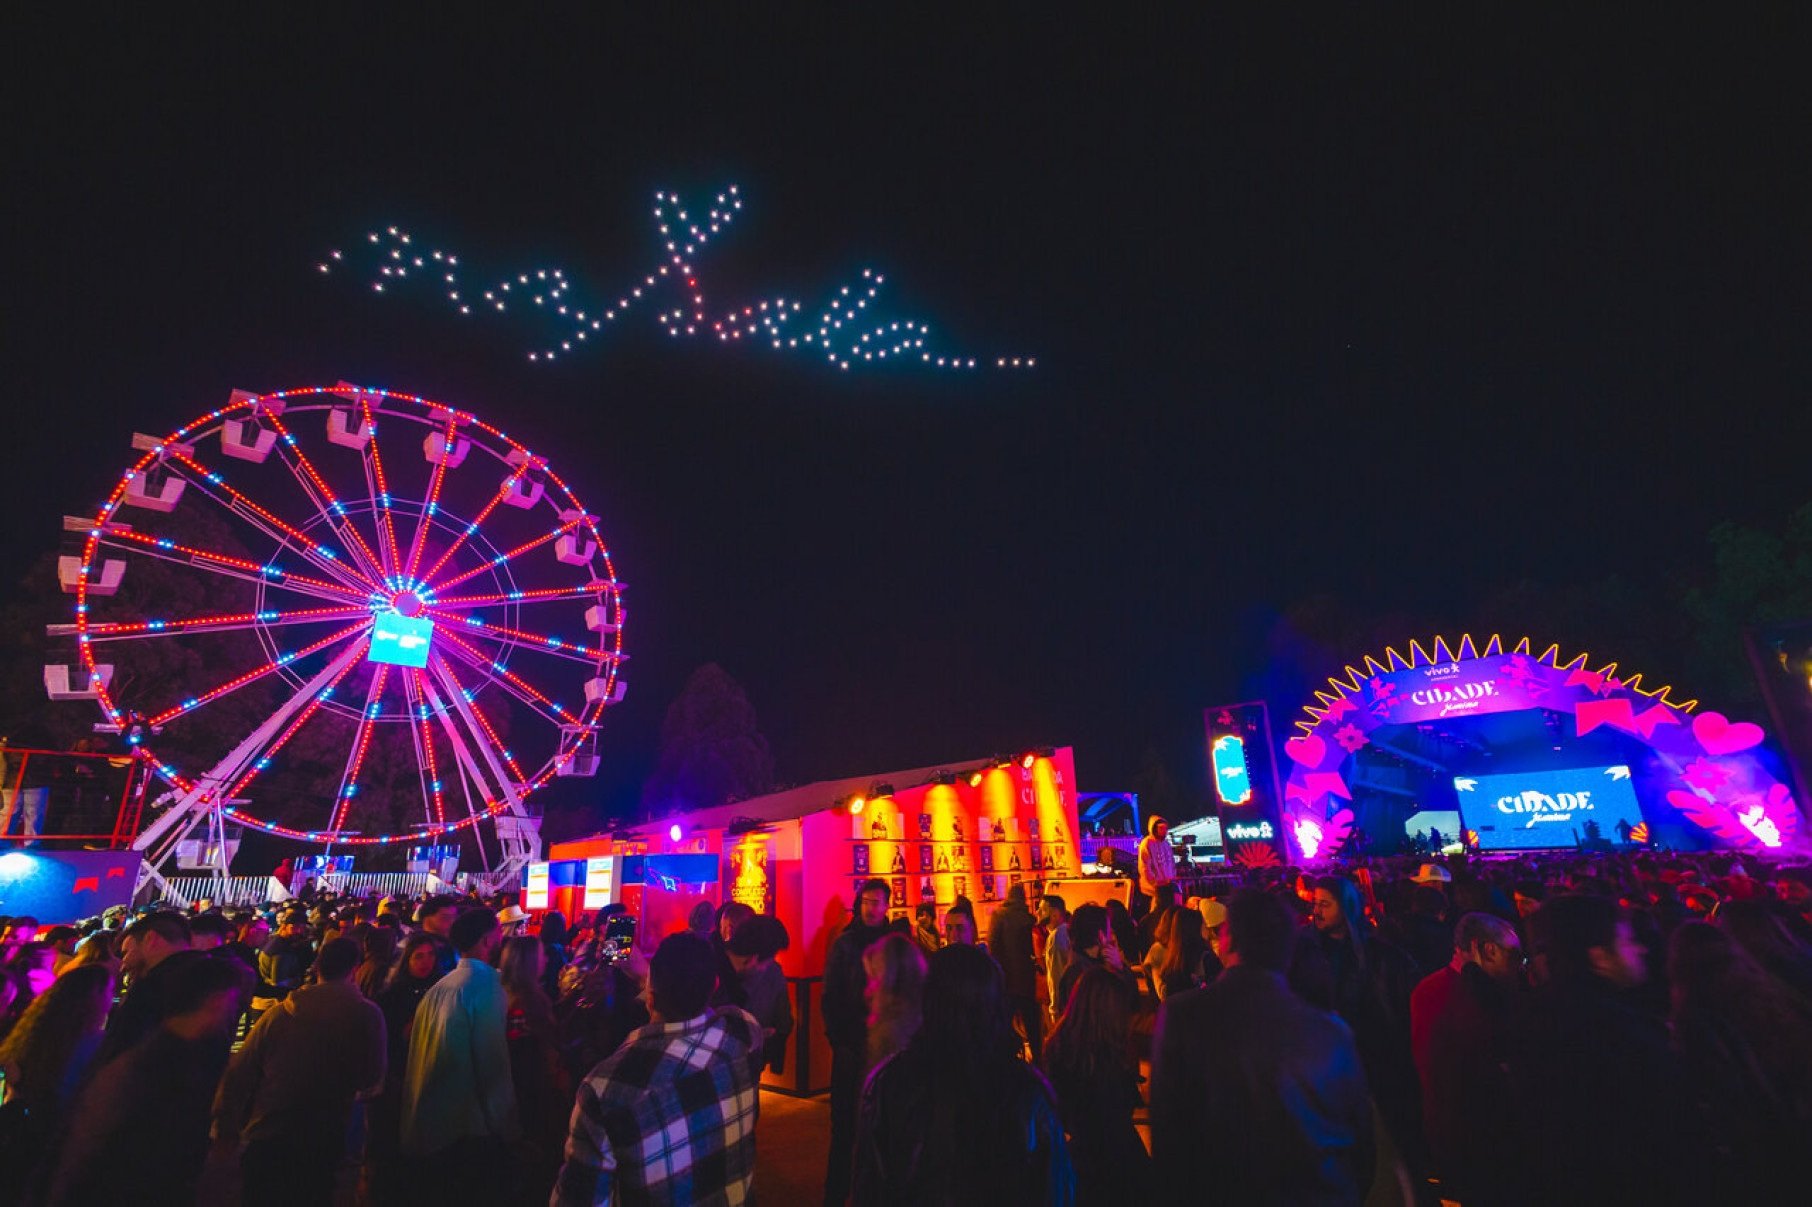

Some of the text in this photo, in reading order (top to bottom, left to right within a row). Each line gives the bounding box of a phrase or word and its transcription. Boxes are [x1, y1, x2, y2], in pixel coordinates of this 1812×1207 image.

[1424, 667, 1450, 677] vivo
[1412, 681, 1499, 706] CIDADE
[1497, 791, 1594, 814] CIDADE
[1227, 823, 1260, 839] vivo
